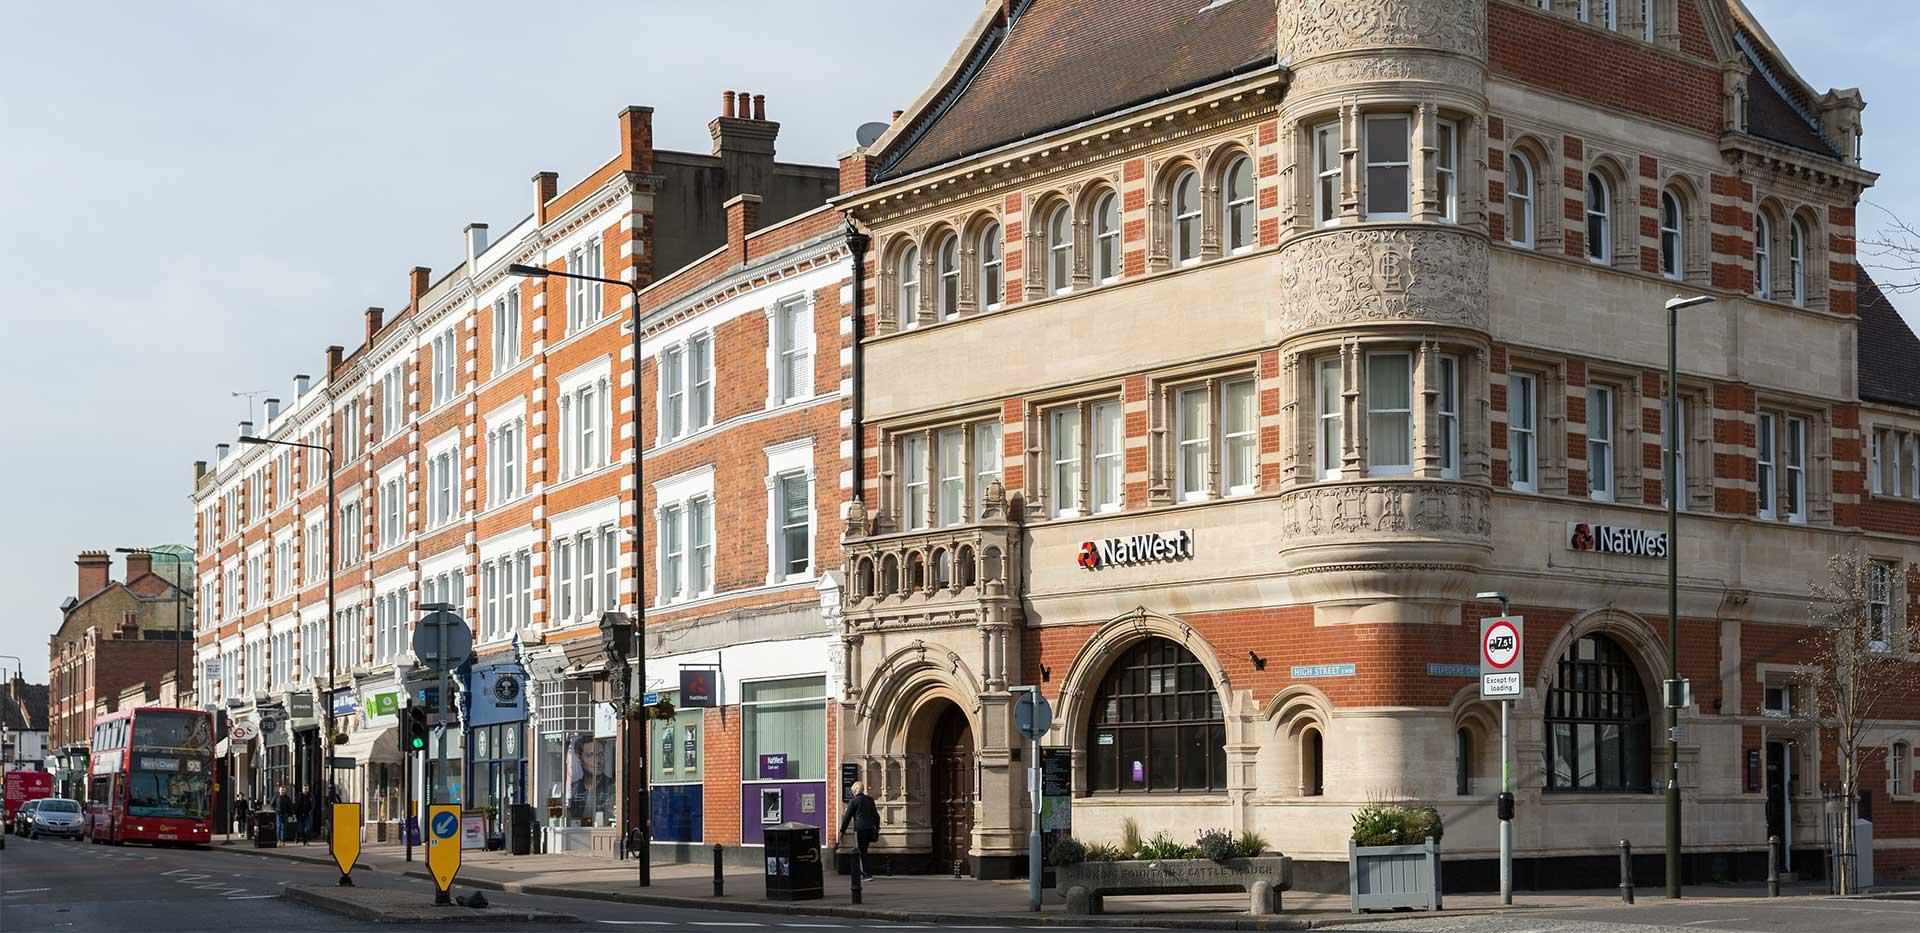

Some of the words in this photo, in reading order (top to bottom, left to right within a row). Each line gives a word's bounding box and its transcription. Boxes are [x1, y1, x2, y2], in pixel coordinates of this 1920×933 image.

[1102, 530, 1186, 565] NatWest
[1294, 667, 1312, 676] HIGH
[1313, 666, 1340, 675] STREET
[1486, 676, 1507, 685] Except
[1508, 675, 1518, 684] for
[1490, 684, 1513, 693] loading
[187, 761, 201, 772] 93
